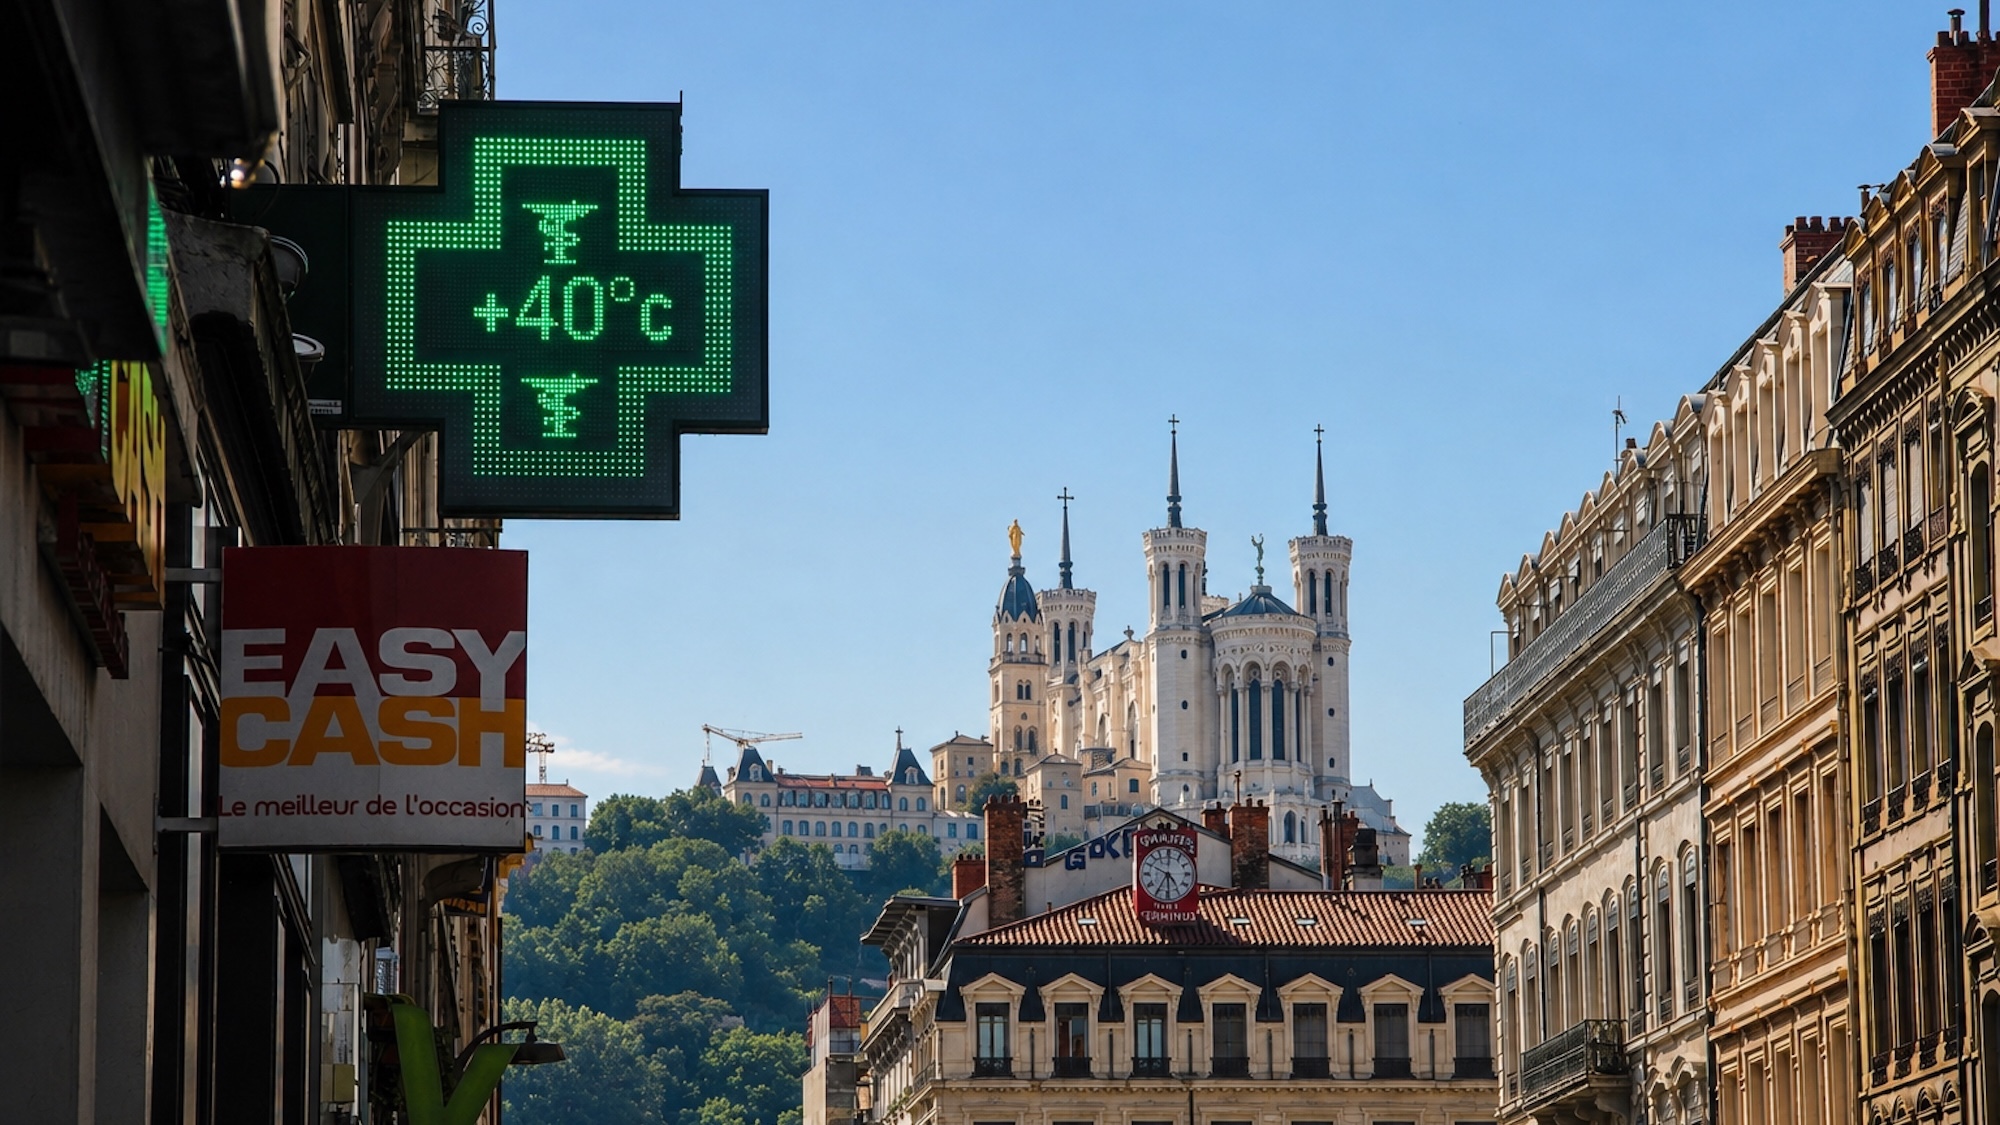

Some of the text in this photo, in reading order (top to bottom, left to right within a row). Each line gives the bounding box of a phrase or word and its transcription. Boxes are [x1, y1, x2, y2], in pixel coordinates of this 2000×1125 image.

[222, 627, 525, 712] EASY
[219, 695, 525, 768] CASH
[218, 794, 525, 818] Le meilleur de l'occasion
